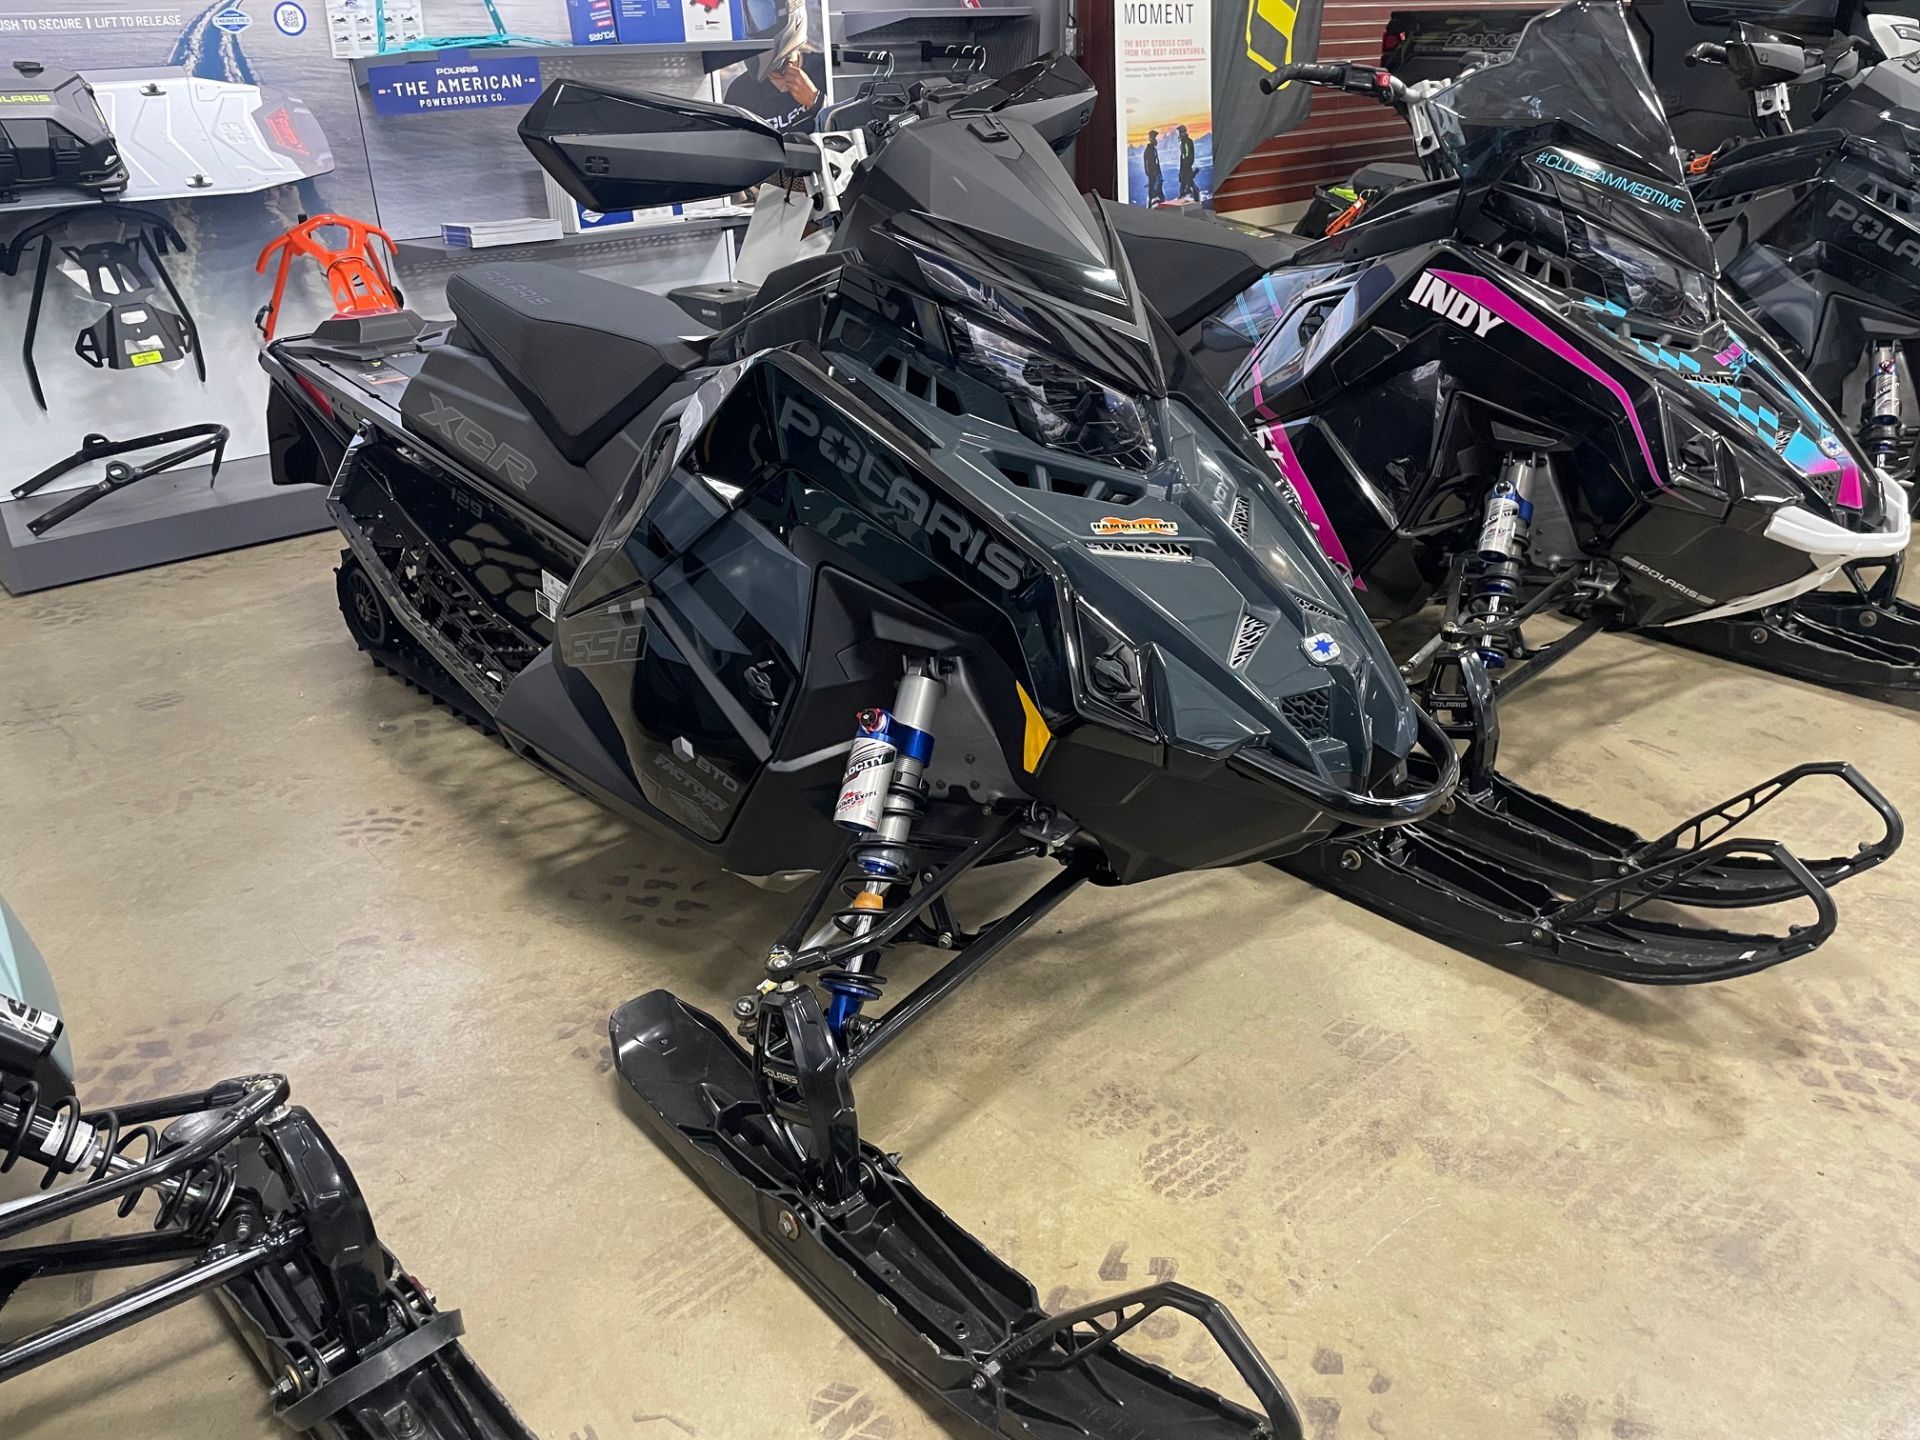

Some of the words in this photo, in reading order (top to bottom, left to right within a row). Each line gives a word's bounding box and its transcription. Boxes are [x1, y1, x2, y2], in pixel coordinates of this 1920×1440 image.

[21, 19, 37, 31] TO
[38, 18, 82, 30] SECURE
[95, 16, 117, 29] LIFT
[119, 16, 134, 27] TO
[136, 15, 182, 27] RELEASE
[1124, 3, 1194, 25] MOMENT
[436, 66, 479, 75] POLARIS
[393, 81, 430, 97] THE
[437, 73, 522, 94] AMERICAN
[0, 94, 50, 103] LARIS
[419, 96, 488, 109] POWERSPORTS
[491, 95, 506, 104] CO.
[1827, 199, 1920, 270] POLA
[1408, 271, 1505, 338] INDY
[418, 391, 538, 492] XCR
[779, 397, 1025, 591] POLARIS
[1638, 563, 1699, 598] POLARIS
[843, 755, 884, 778] LOCITY
[762, 1066, 798, 1084] POLARIS
